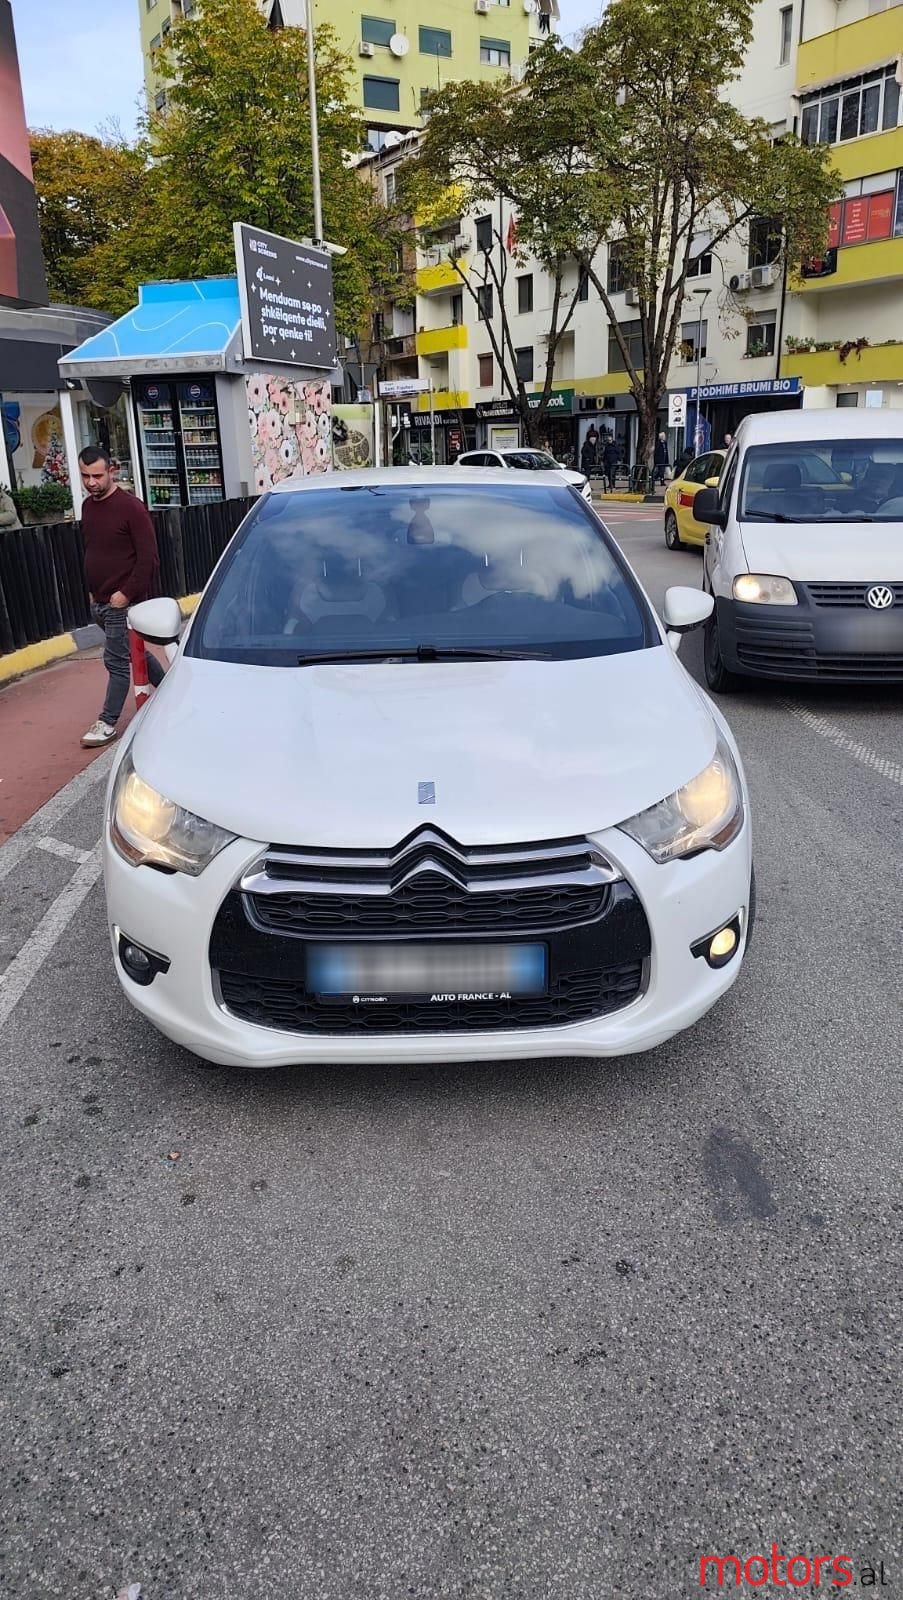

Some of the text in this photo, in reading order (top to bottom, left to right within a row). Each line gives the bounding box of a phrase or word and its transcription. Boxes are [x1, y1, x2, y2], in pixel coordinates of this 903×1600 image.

[259, 287, 301, 308] Menduam
[261, 305, 306, 325] shkëlqente
[262, 324, 278, 337] por
[278, 327, 304, 340] qenke
[691, 380, 791, 398] PRODHIME BRUMI BIO
[430, 994, 456, 1002] AUTO
[457, 992, 494, 1001] FRANCE
